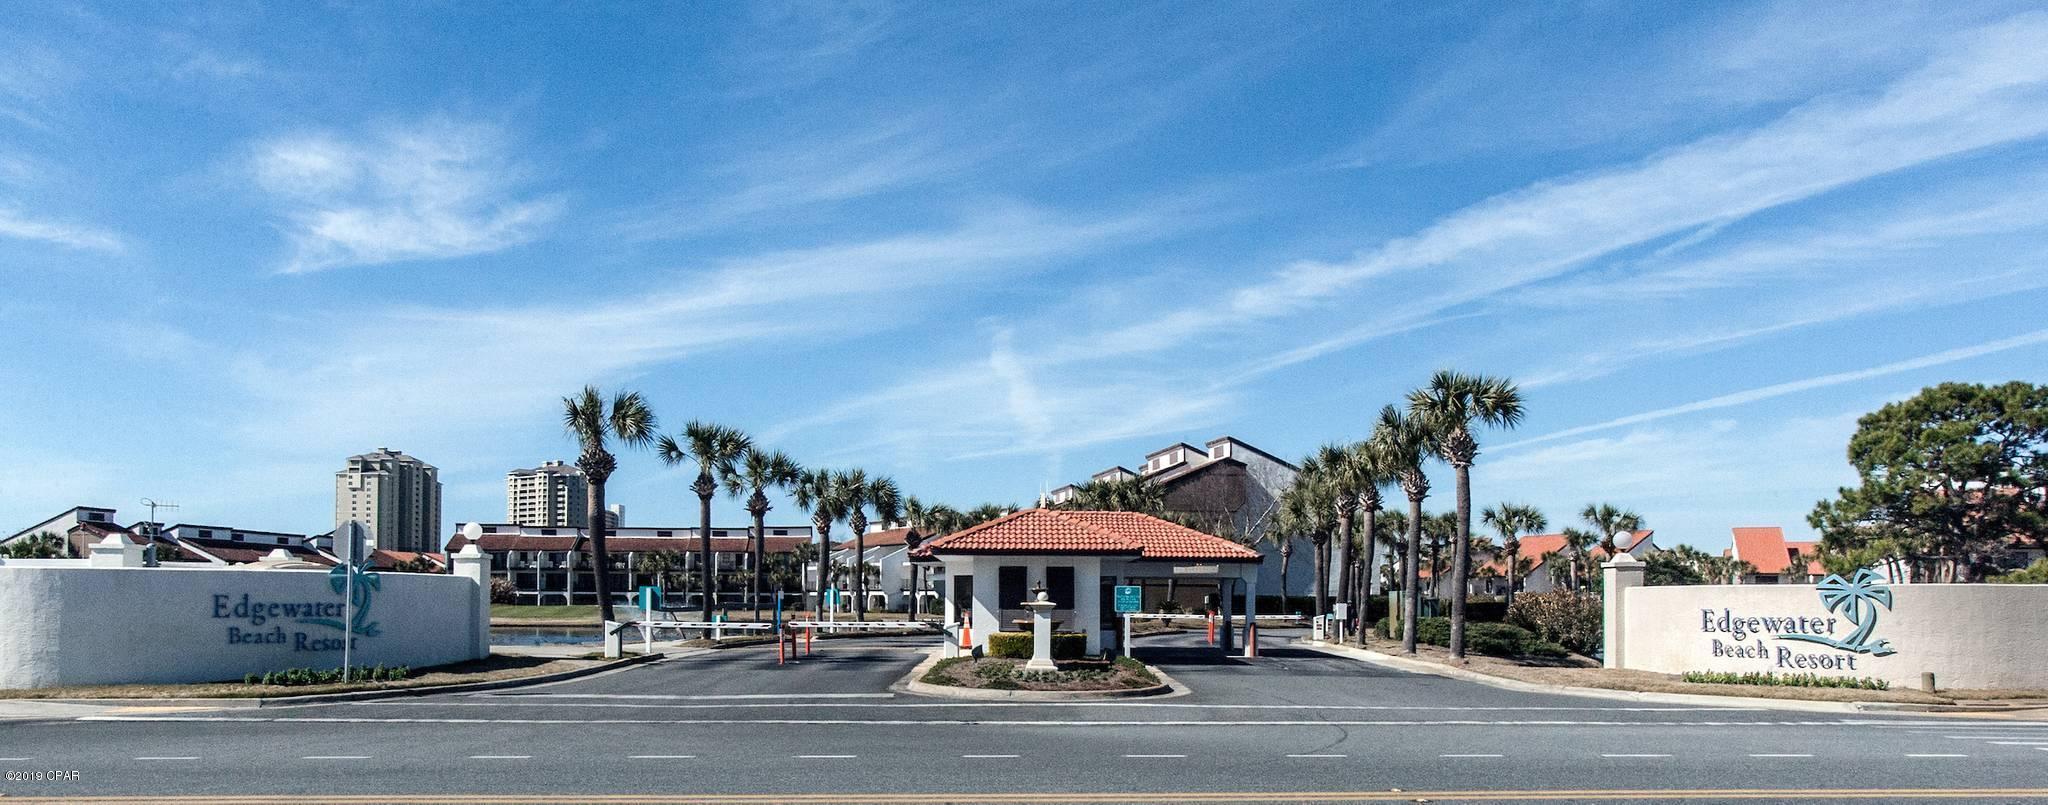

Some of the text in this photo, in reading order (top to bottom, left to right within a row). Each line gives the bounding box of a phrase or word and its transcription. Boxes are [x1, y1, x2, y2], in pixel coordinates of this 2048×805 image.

[212, 593, 345, 626] Edgewater
[1700, 608, 1837, 641] Edgewater
[228, 627, 287, 645] Beach
[1712, 639, 1857, 670] Beach Resort
